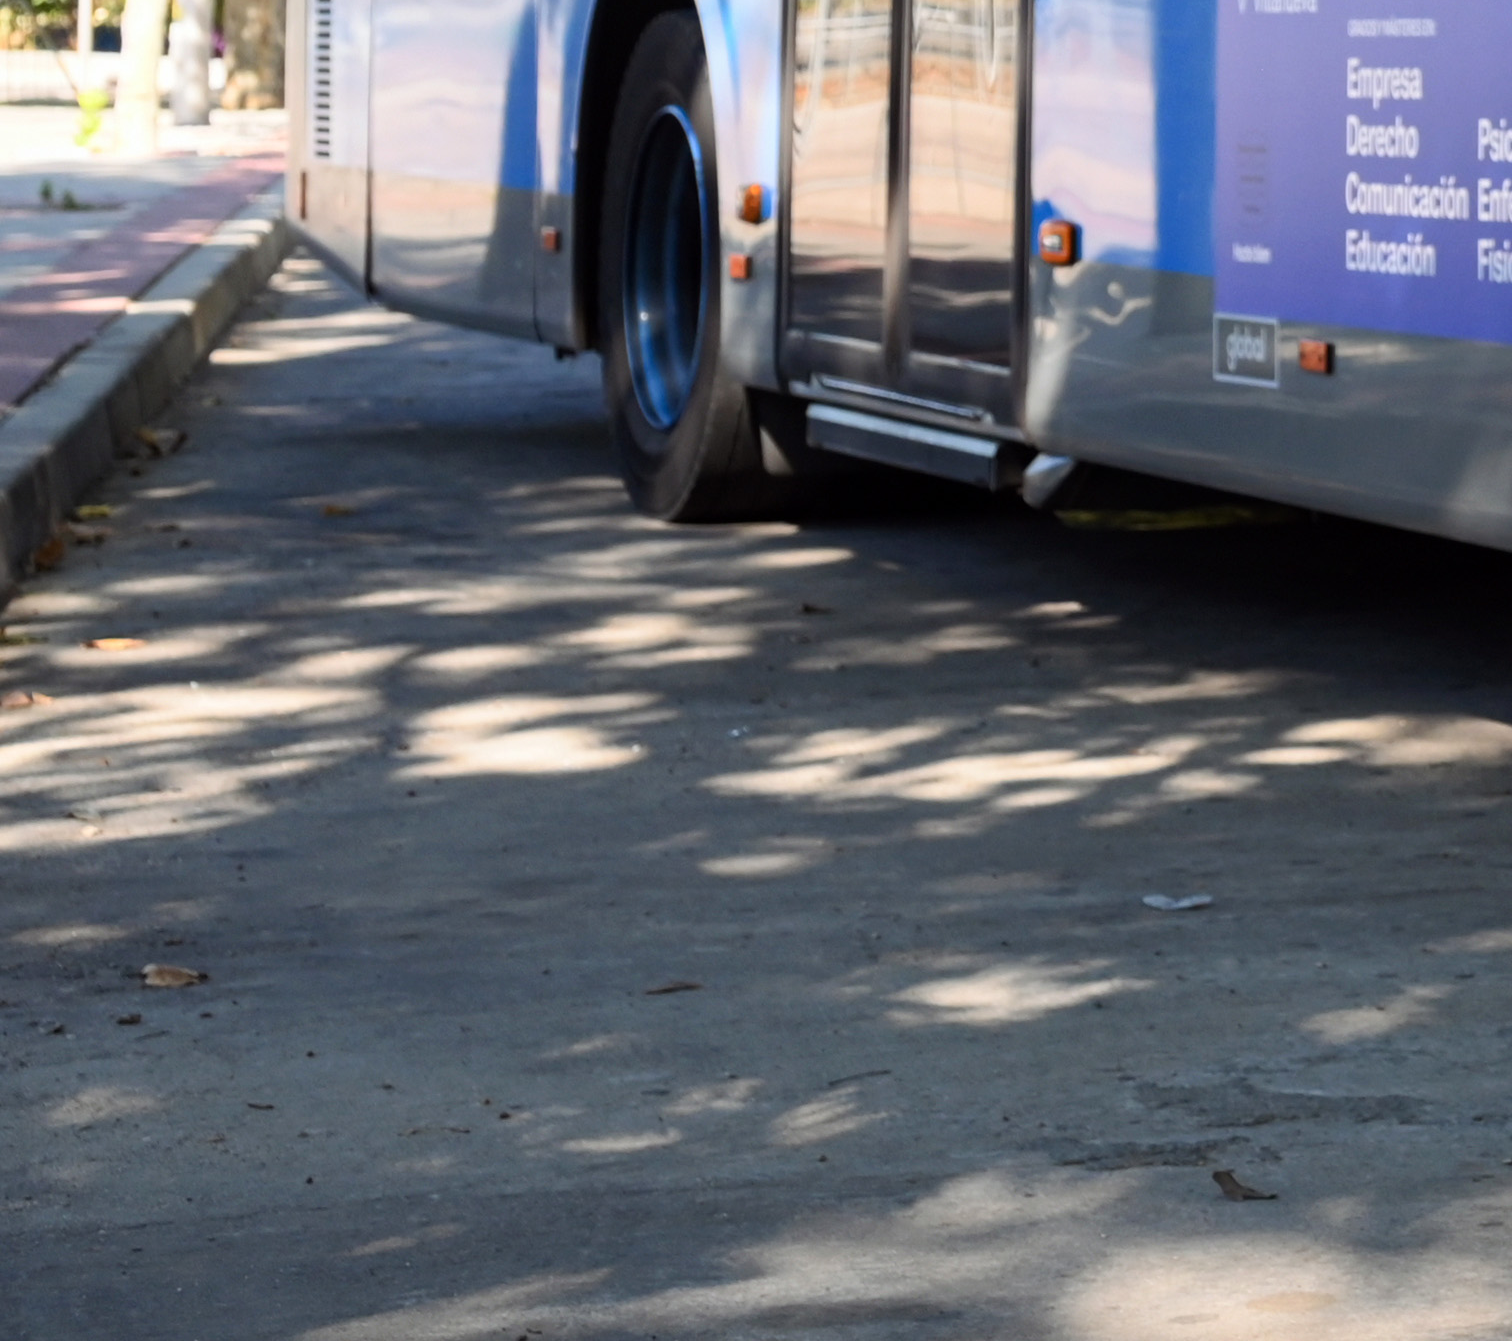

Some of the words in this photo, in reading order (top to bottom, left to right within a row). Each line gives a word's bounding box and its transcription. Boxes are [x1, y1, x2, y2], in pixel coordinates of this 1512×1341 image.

[1346, 56, 1423, 110] Empresa
[1346, 115, 1420, 159] Derecho
[1345, 171, 1470, 220] Comunicación
[1345, 228, 1437, 278] Educación
